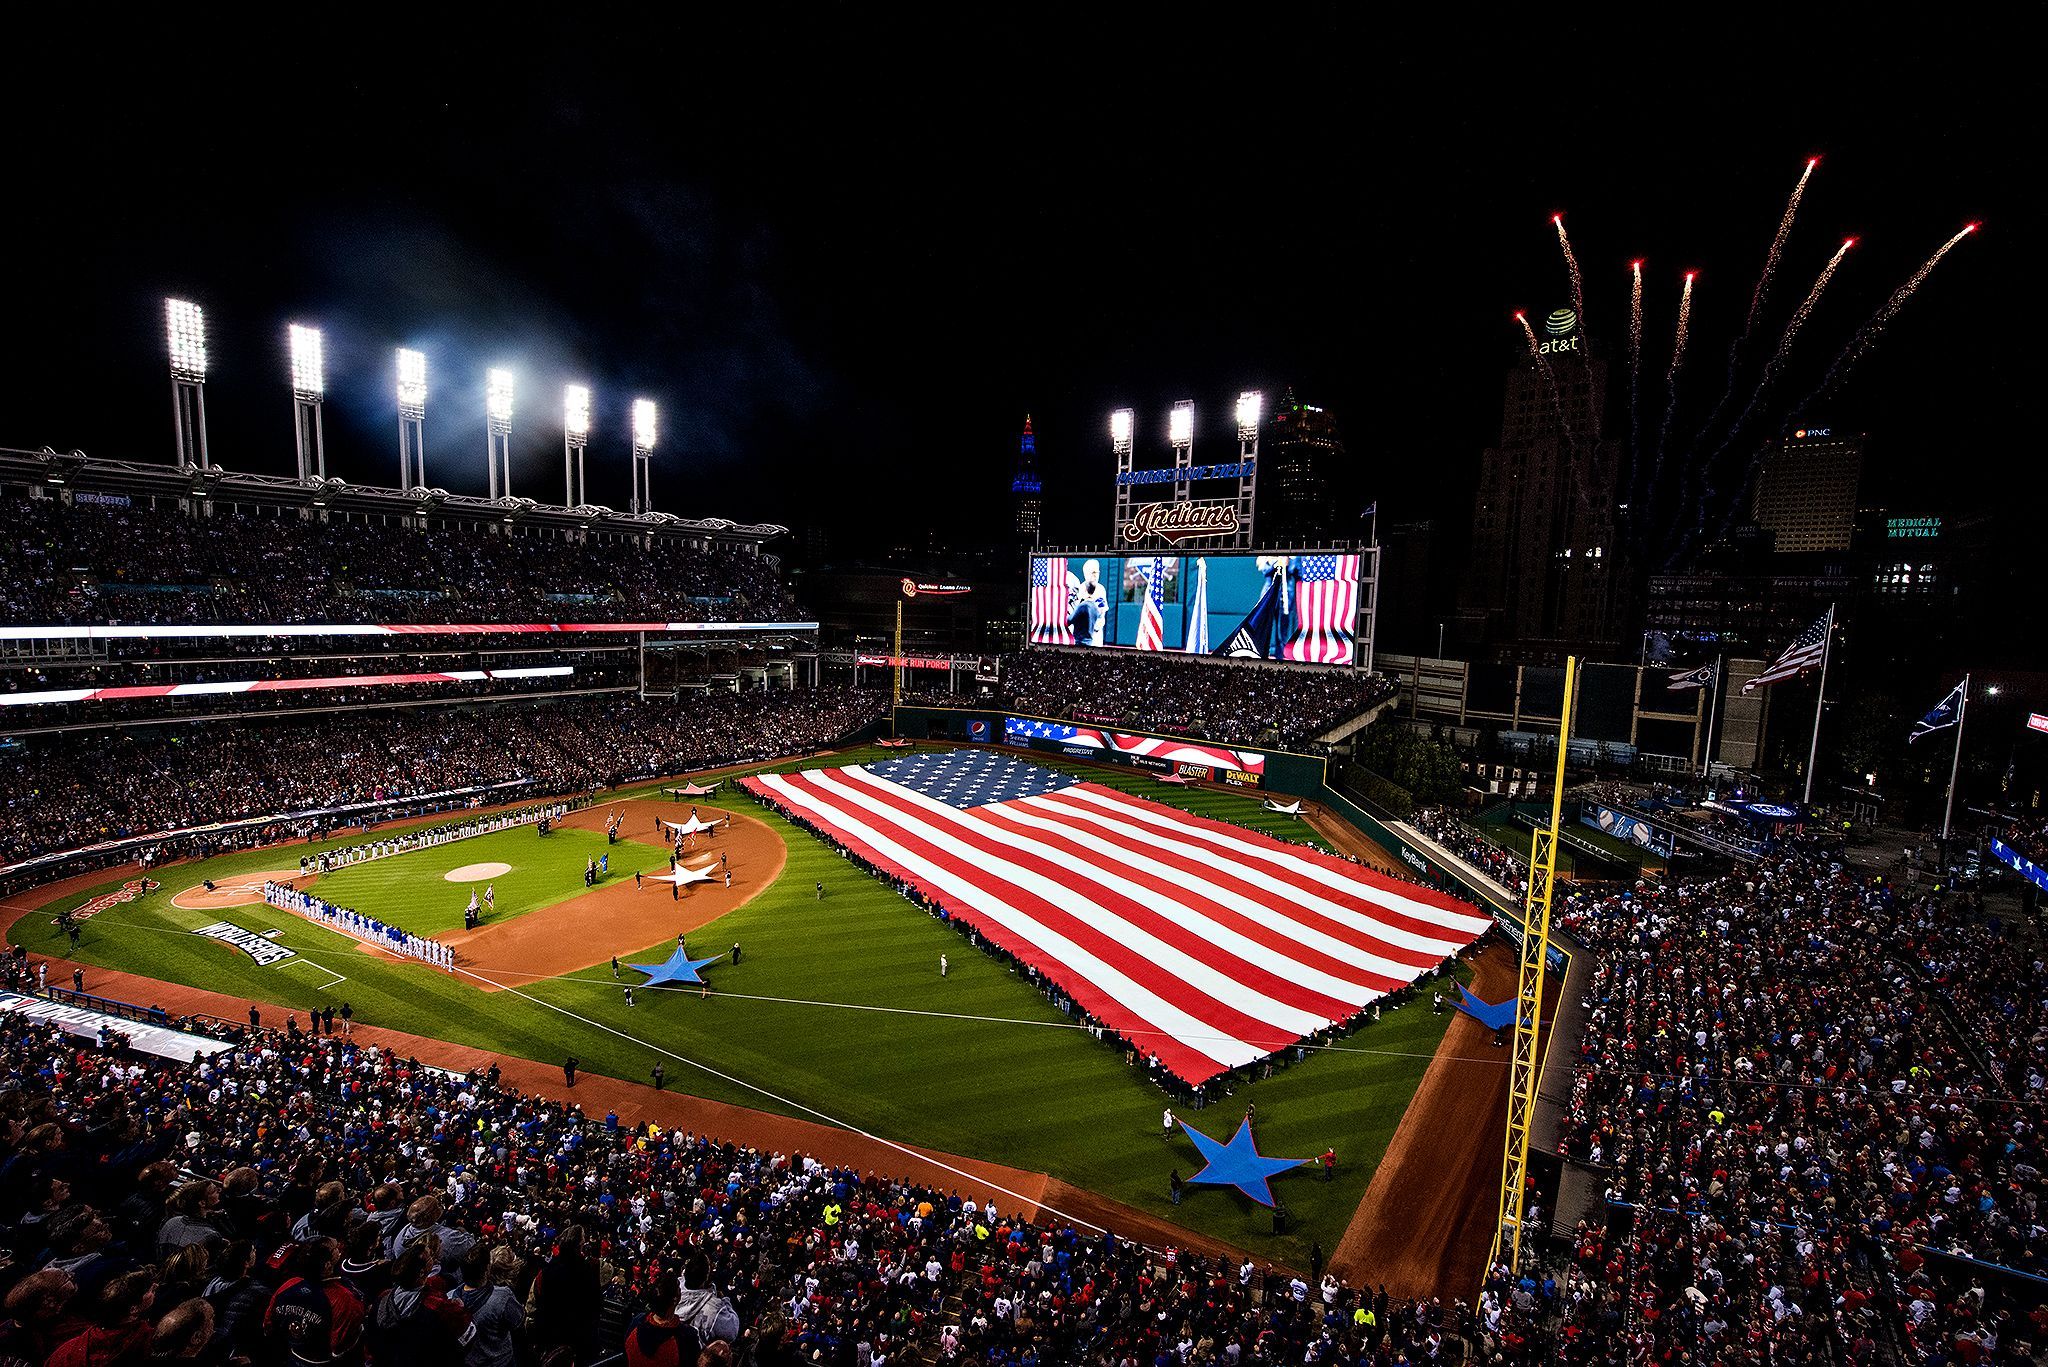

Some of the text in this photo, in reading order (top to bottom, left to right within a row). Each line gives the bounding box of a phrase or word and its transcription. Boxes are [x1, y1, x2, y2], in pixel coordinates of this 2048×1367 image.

[1539, 335, 1579, 354] at&t
[1807, 428, 1830, 437] PNC
[1210, 461, 1255, 479] FIELD
[1123, 501, 1240, 545] Indians
[1887, 517, 1942, 528] MEDICAL
[1887, 527, 1939, 538] MUTUAL
[909, 659, 925, 668] RUN
[925, 660, 951, 670] PORCH
[1062, 746, 1095, 756] PROGRESSIVE
[1179, 764, 1208, 779] BLASTER
[1401, 846, 1427, 873] KeyBank
[191, 920, 298, 966] WORLD SERIES
